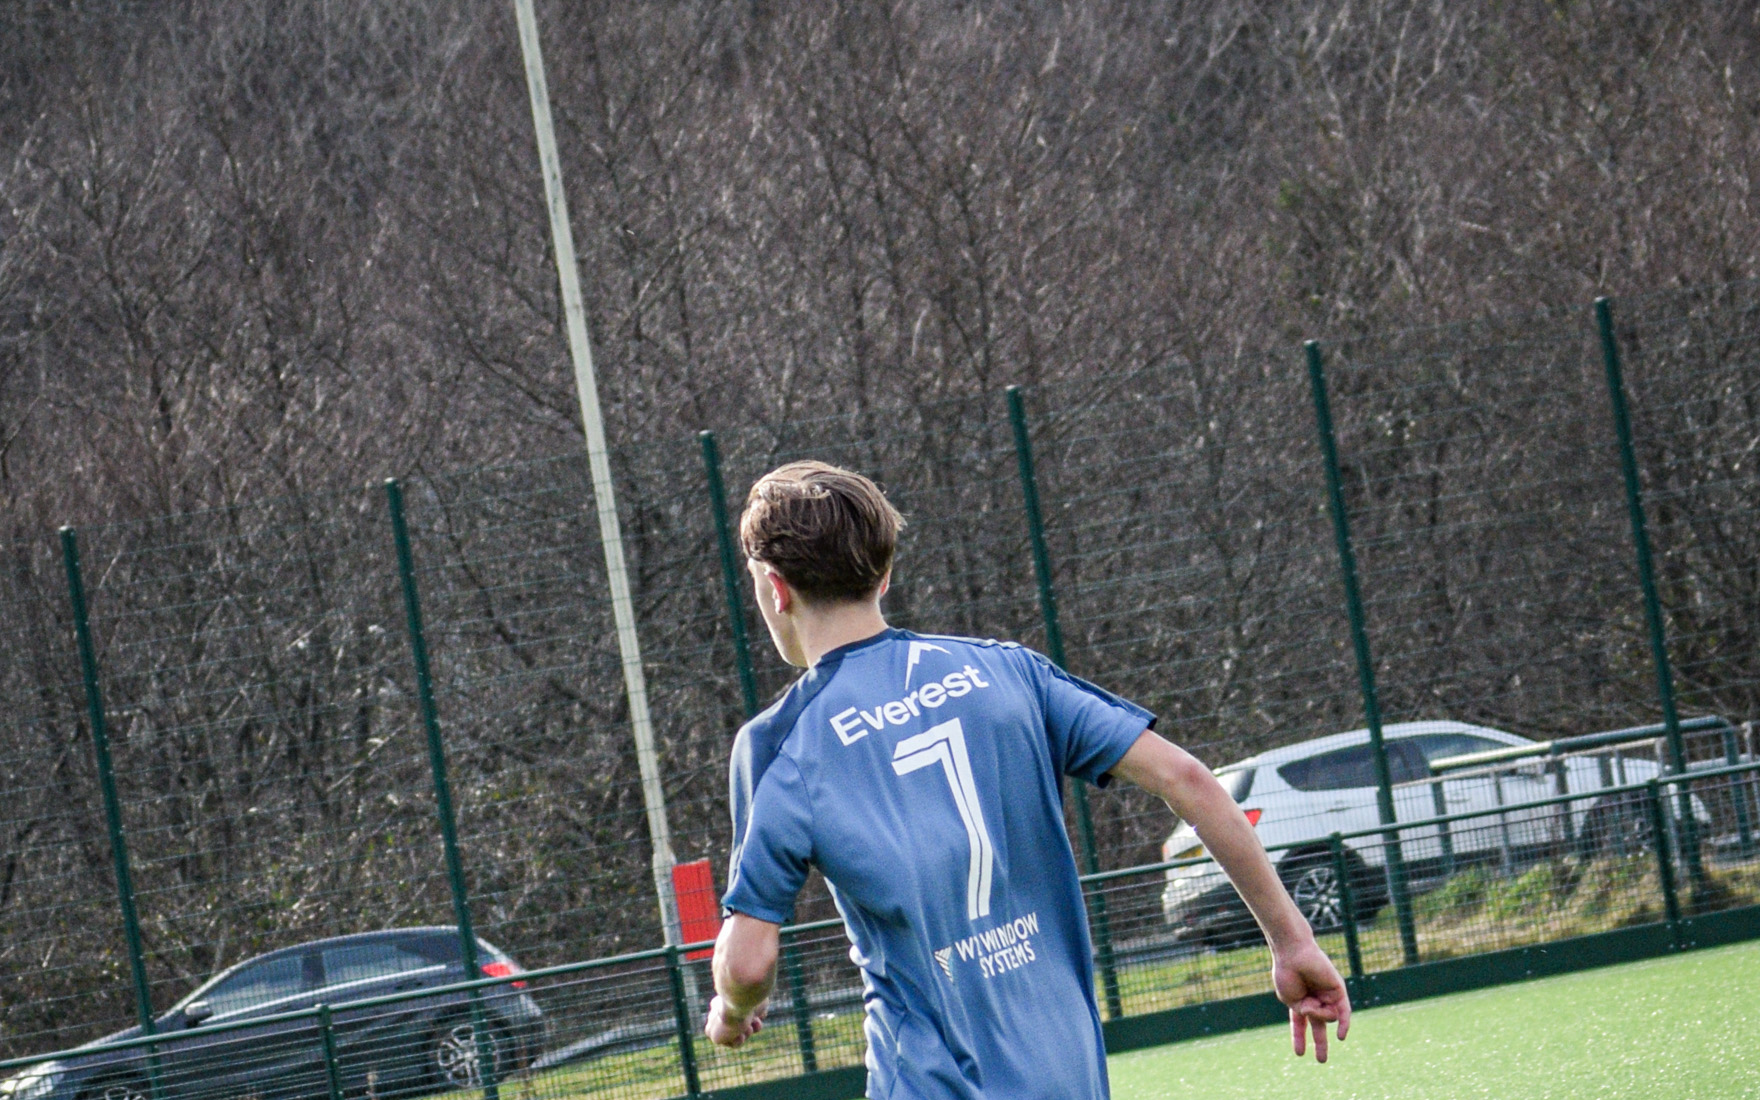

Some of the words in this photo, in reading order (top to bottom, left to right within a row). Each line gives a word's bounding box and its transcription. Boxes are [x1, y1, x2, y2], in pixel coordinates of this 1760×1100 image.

[829, 664, 989, 746] Everest
[891, 717, 993, 921] 7
[979, 911, 1039, 952] WINDOW
[980, 940, 1036, 979] SYSTEMS
